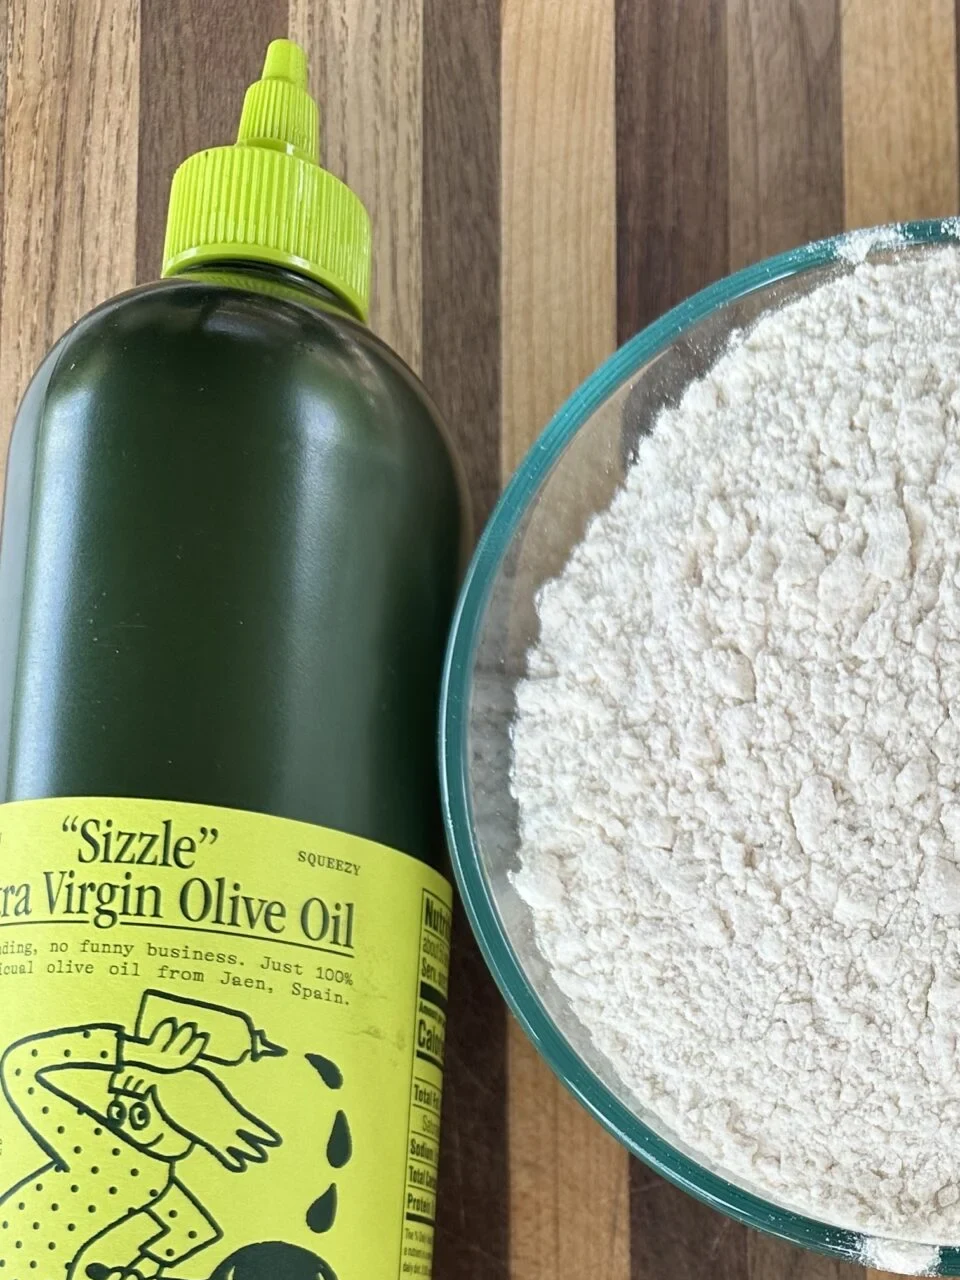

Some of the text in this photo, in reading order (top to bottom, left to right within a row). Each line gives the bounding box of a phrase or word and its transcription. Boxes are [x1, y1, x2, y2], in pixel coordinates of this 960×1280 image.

[297, 850, 362, 877] SQUEEZY
[43, 870, 163, 930] Virgin
[179, 876, 288, 935] Olive
[300, 896, 356, 950] Oil
[46, 959, 95, 976] olive
[108, 962, 142, 978] oil
[157, 964, 205, 983] from
[219, 970, 275, 994] Jaen,
[291, 982, 351, 1007] Spain.
[49, 941, 69, 954] no
[79, 939, 135, 957] funny
[147, 942, 246, 967] business.
[260, 955, 304, 976] Just
[316, 966, 355, 986] 100%
